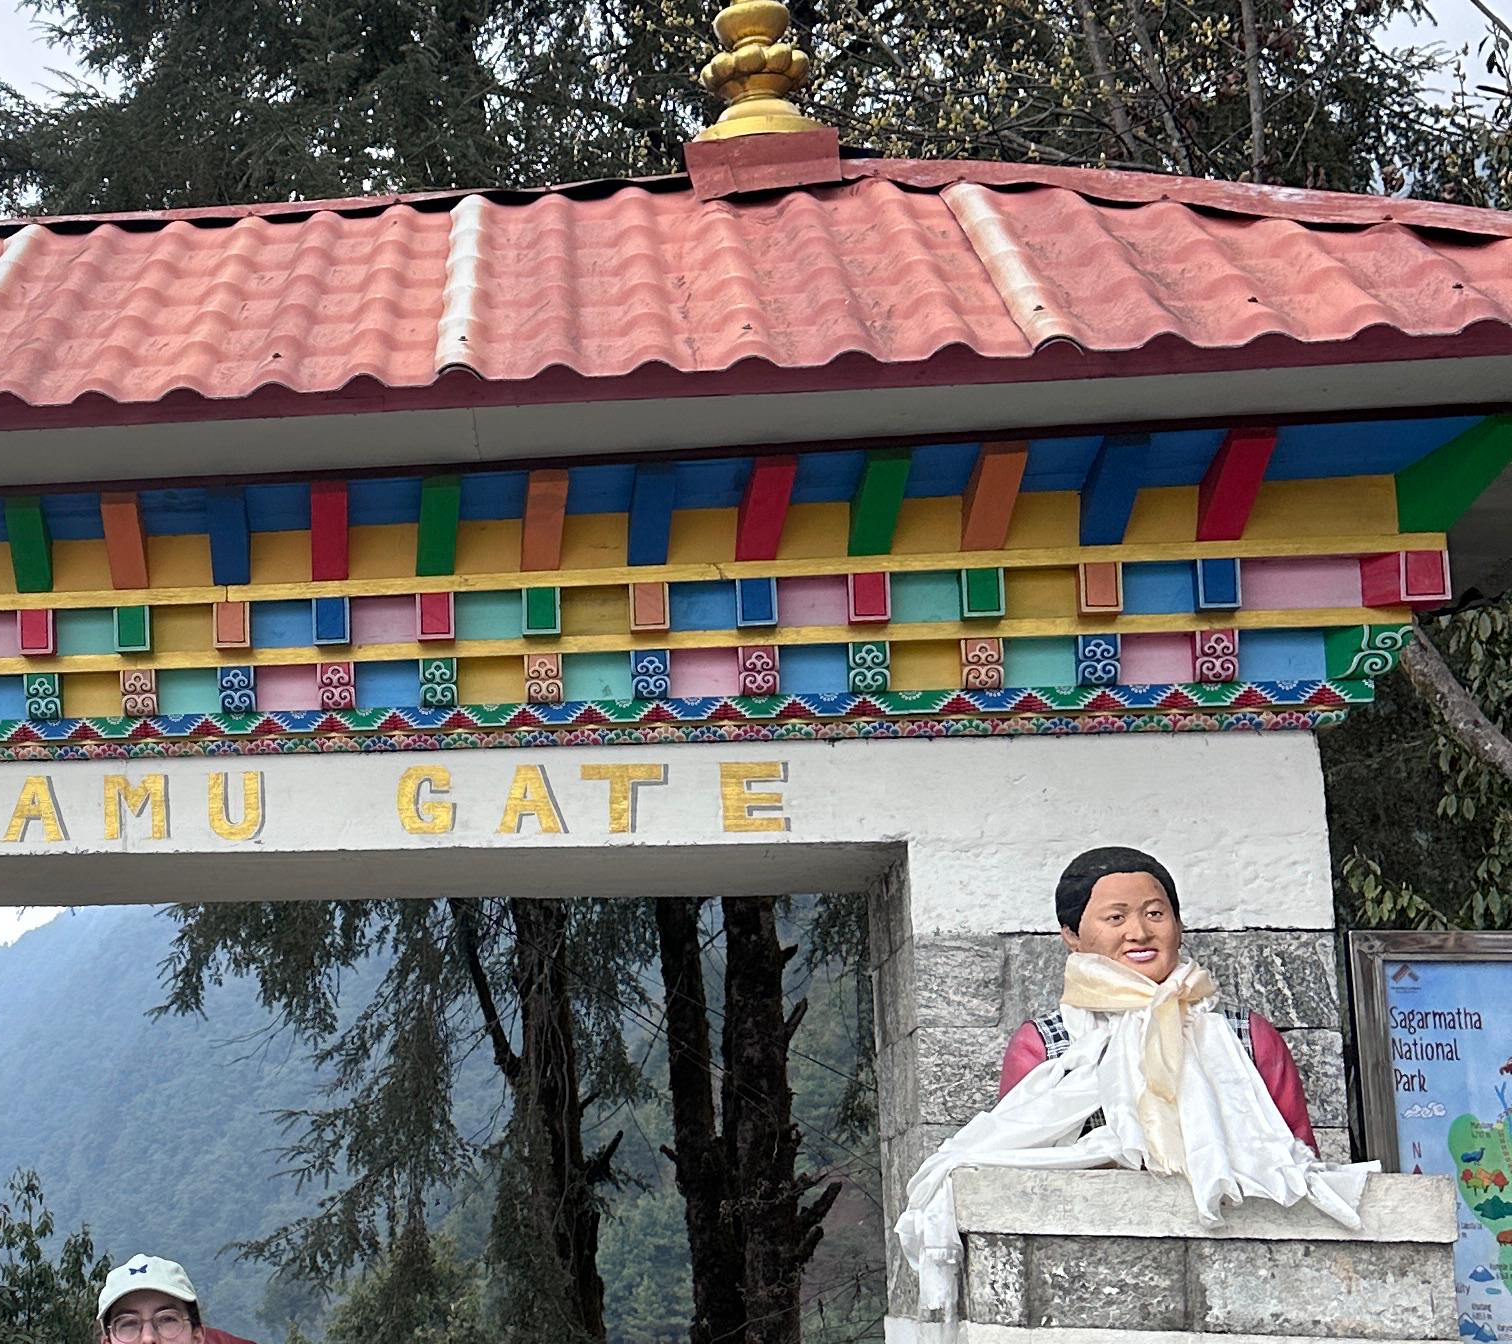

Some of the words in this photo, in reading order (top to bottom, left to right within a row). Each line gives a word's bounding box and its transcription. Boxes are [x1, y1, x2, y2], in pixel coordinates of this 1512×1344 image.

[396, 762, 792, 834] GATE
[1389, 1006, 1483, 1035] Sagarmatha
[1391, 1037, 1461, 1061] National
[1393, 1068, 1428, 1093] Park
[1411, 1141, 1423, 1158] N
